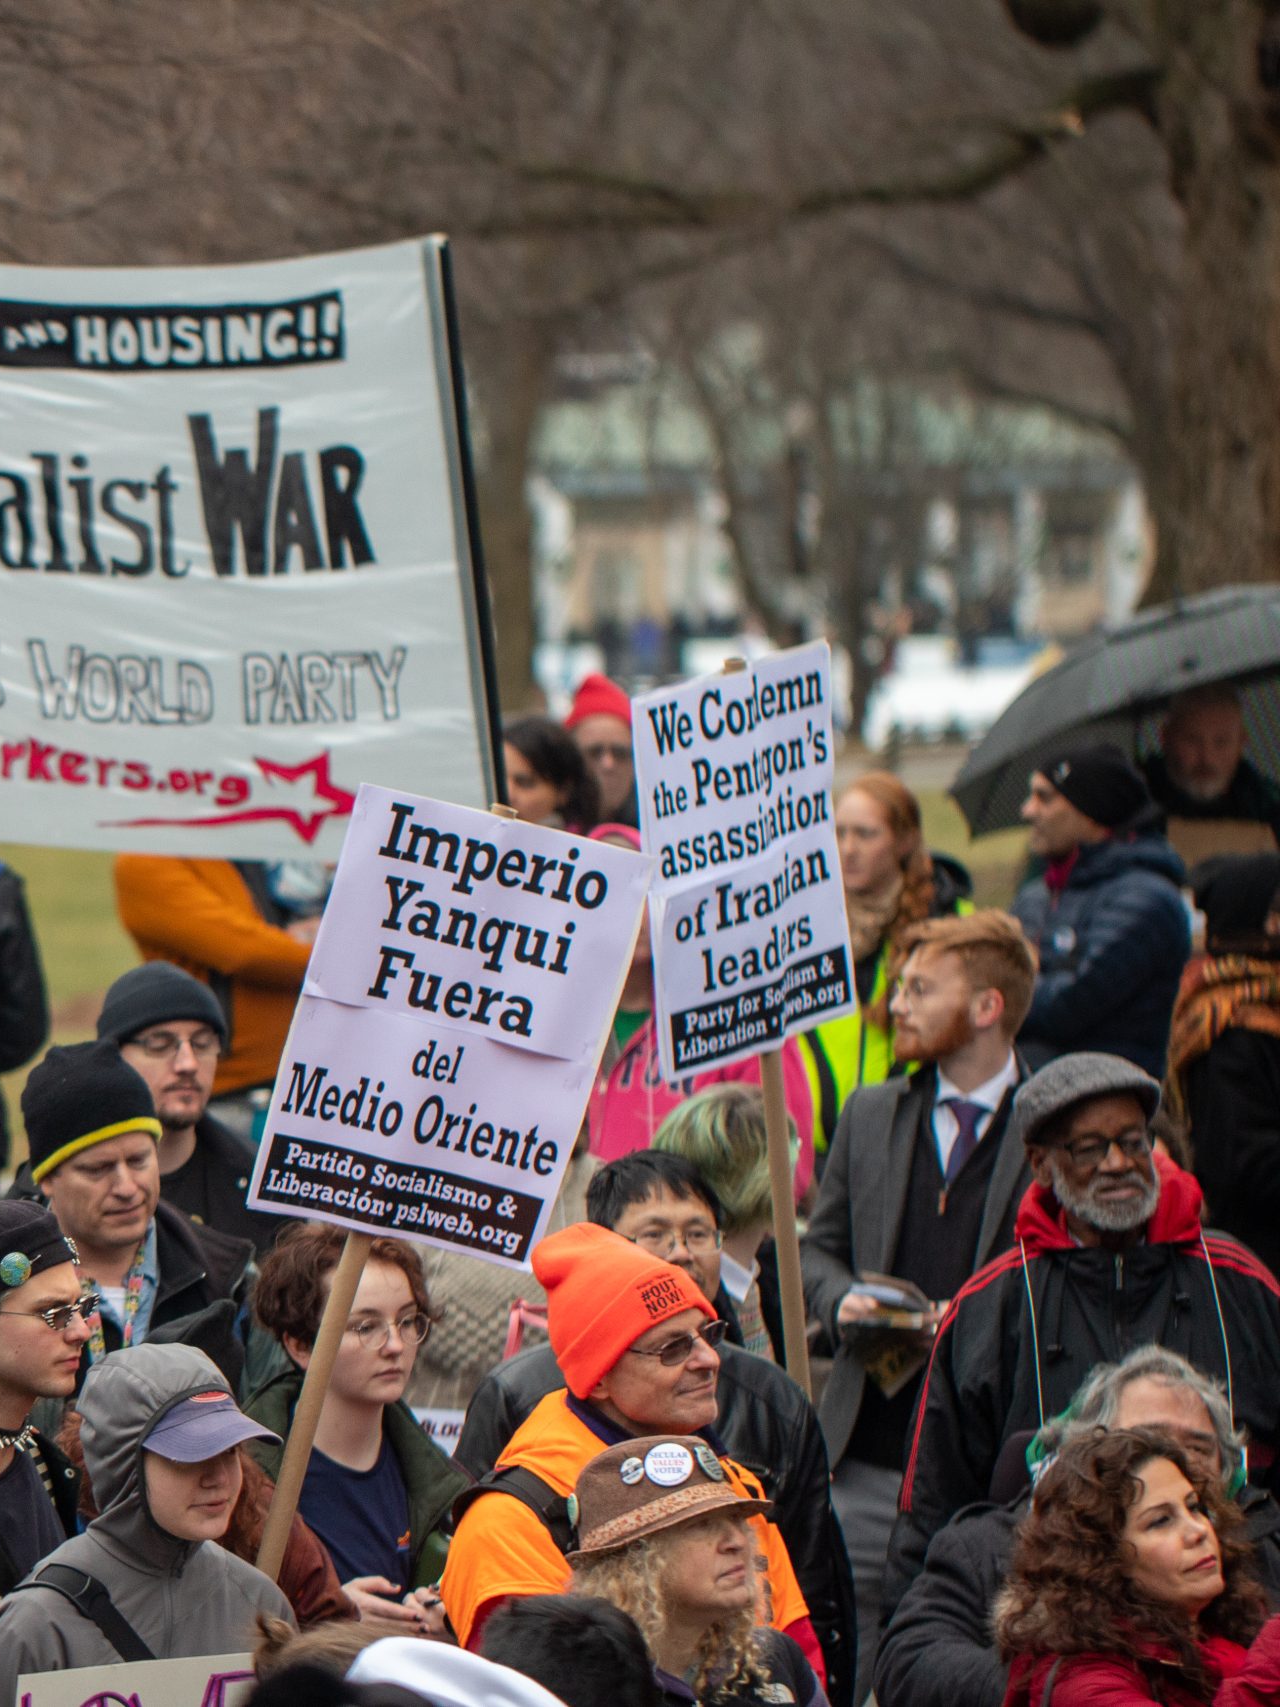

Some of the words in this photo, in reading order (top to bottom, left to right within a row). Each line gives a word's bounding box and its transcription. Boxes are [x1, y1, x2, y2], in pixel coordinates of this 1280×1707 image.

[3, 319, 68, 352] AND
[72, 299, 340, 366] HOUSING!!
[188, 406, 377, 577] WAR
[27, 638, 214, 726] WORLD
[241, 645, 409, 725] PARTY
[648, 700, 693, 757] We
[653, 781, 688, 820] the
[692, 719, 828, 808] Pentgon's
[377, 801, 608, 911] Imperio
[660, 785, 829, 879] assassiation
[381, 875, 577, 975] Yanqui
[675, 897, 709, 944] of
[367, 945, 534, 1038] Fuera
[685, 1005, 735, 1035] Party
[737, 994, 761, 1020] for
[820, 954, 835, 978] &
[411, 1040, 465, 1085] del
[677, 1017, 768, 1064] Liberation
[280, 1061, 404, 1137] Medio
[412, 1094, 560, 1177] Oriente
[266, 1168, 387, 1217] Liberación
[391, 1201, 524, 1256] pslweb.org
[283, 1142, 367, 1181] Partido
[370, 1163, 493, 1212] Socialismo
[495, 1194, 519, 1219] &
[641, 1278, 677, 1302] #OUT
[646, 1288, 687, 1316] NOW!
[650, 1451, 689, 1459] SECULAR
[654, 1466, 683, 1474] VOTER
